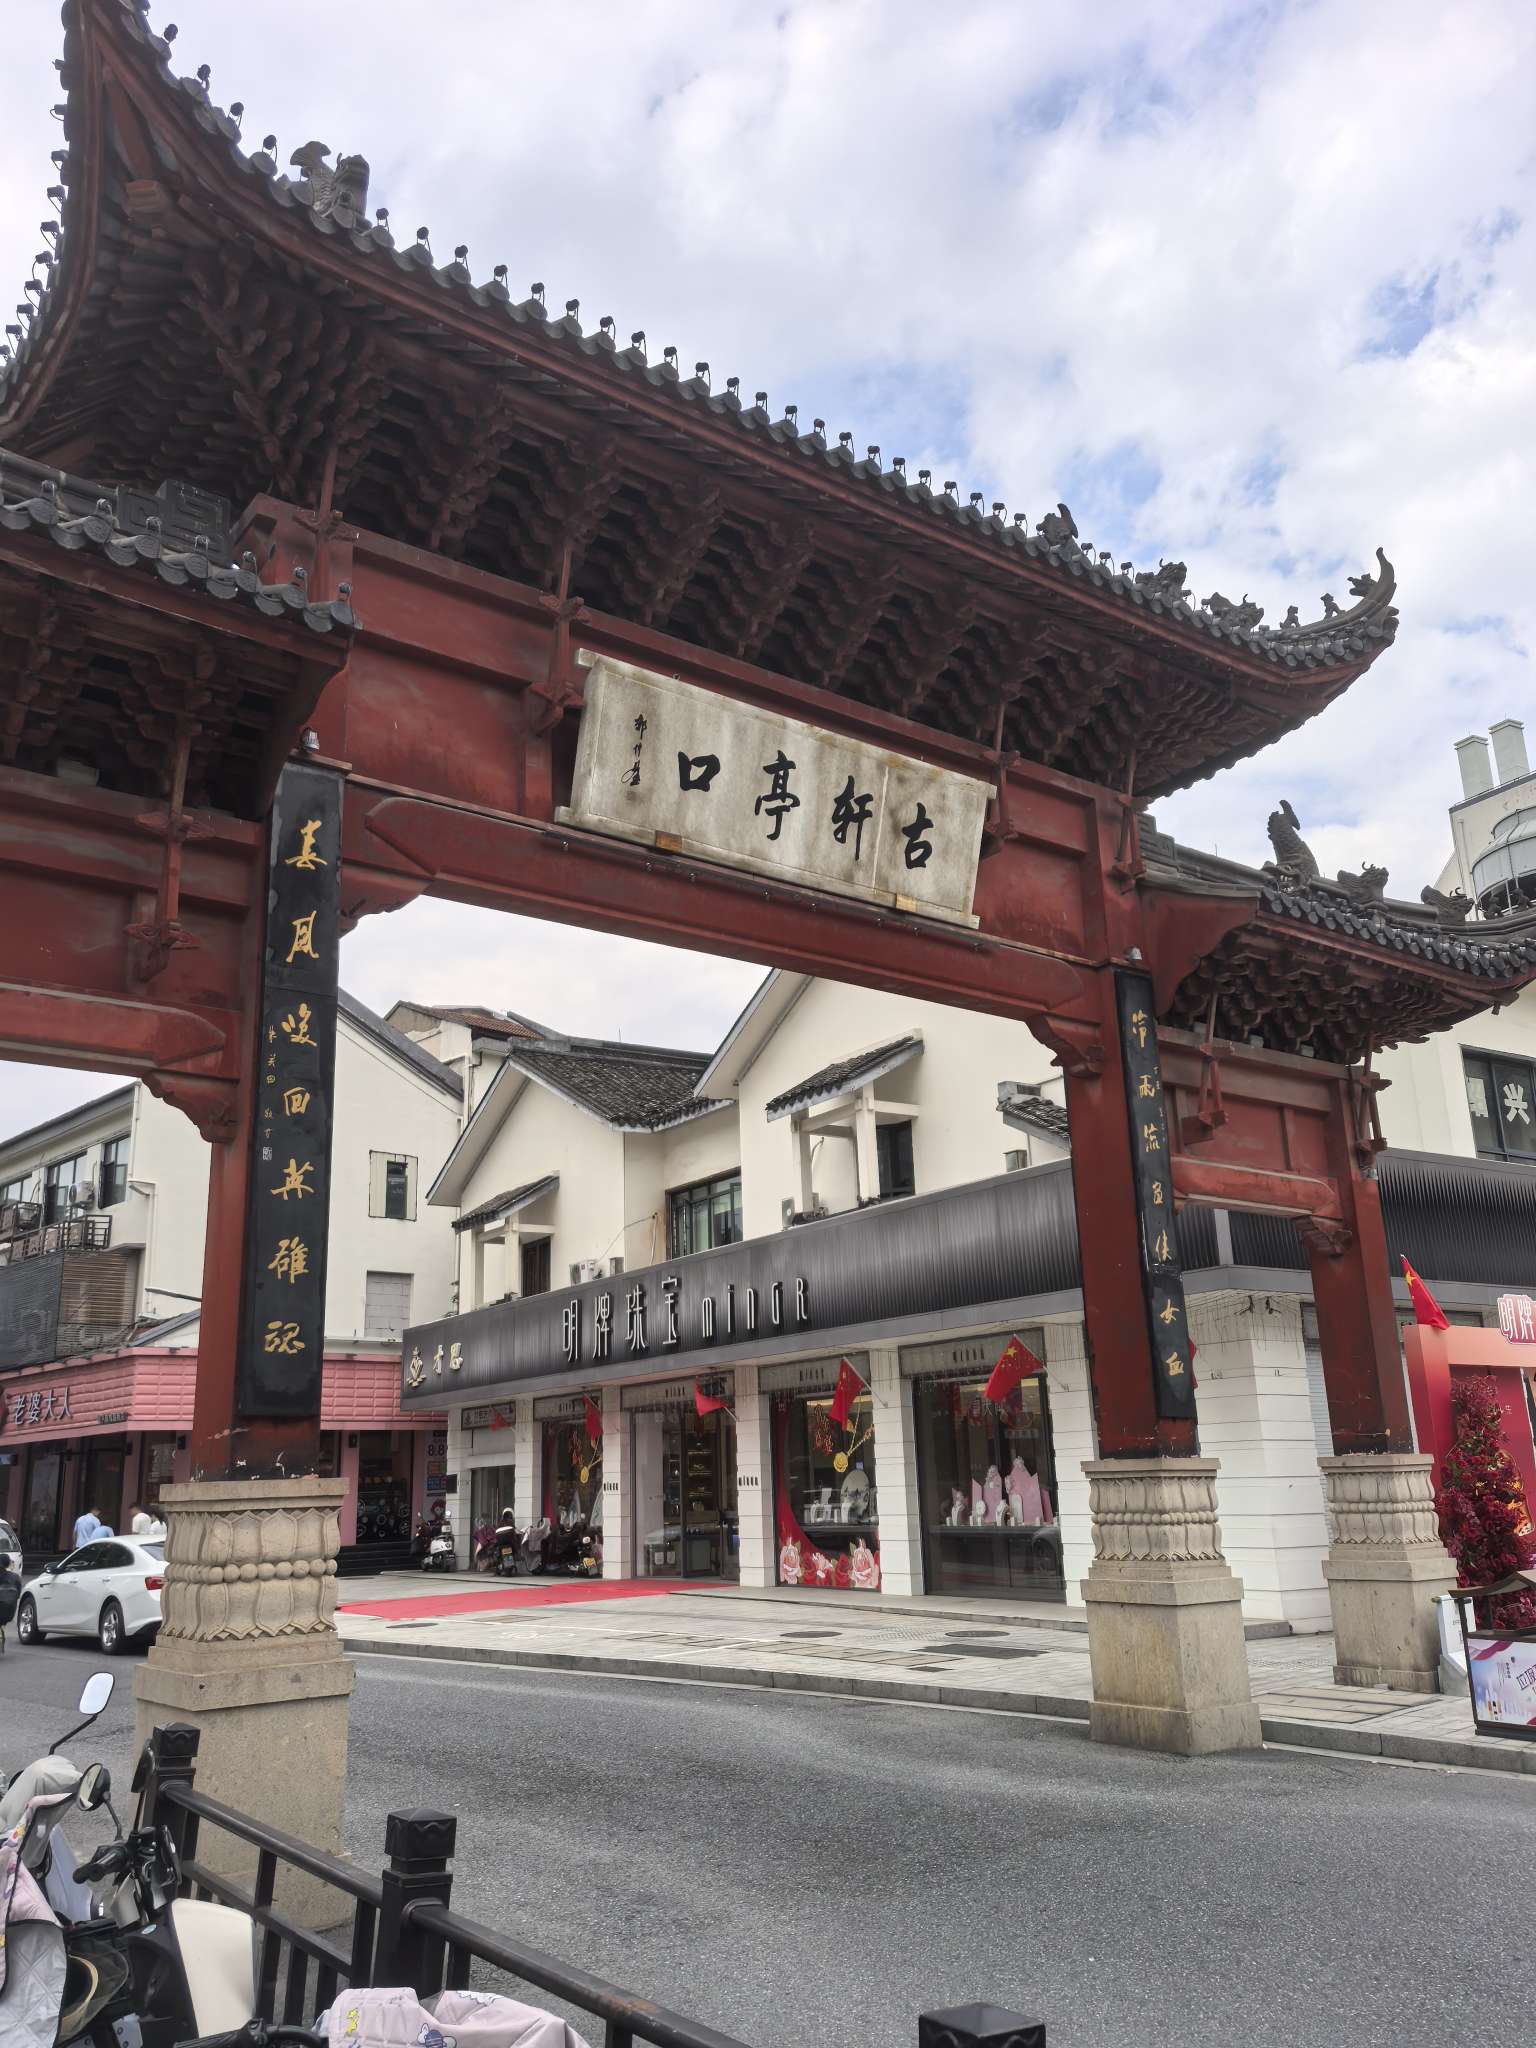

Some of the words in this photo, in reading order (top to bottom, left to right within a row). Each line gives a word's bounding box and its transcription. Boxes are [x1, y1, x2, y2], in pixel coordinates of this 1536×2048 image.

[561, 1275, 679, 1363] 明牌珠宝
[13, 1386, 72, 1426] 老婆大人
